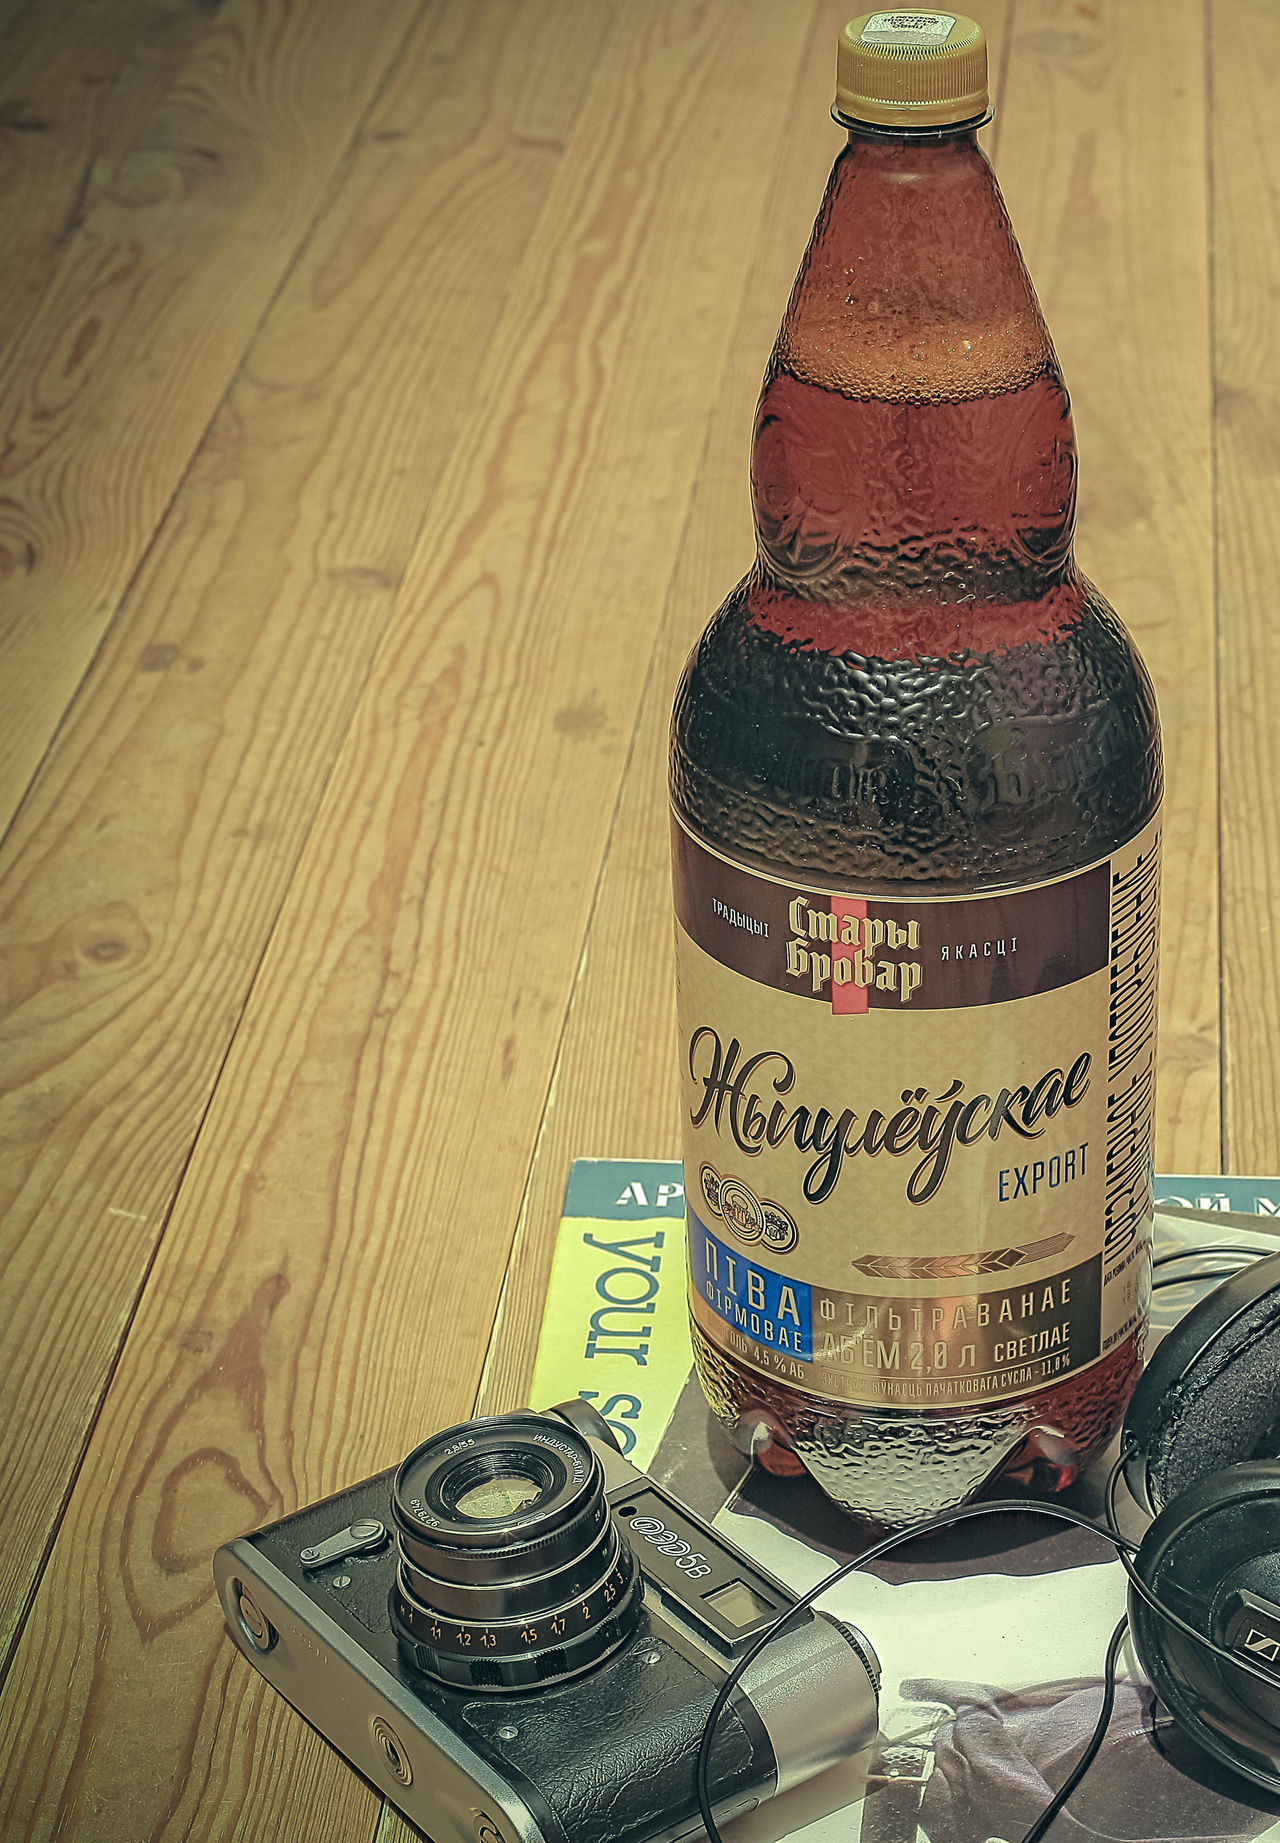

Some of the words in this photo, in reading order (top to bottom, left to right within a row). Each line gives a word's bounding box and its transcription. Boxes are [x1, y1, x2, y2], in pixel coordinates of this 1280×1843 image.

[712, 897, 769, 938] ТРАДЫЦЫІ
[788, 895, 920, 959] Стары
[785, 937, 923, 1004] Бровар
[941, 936, 1018, 962] ЯКАСЦІ
[616, 1181, 684, 1208] АР
[998, 1142, 1089, 1203] EXPORT
[583, 1231, 665, 1367] your
[706, 1237, 801, 1326] ПІВА
[820, 1278, 1071, 1332] ФІЛЬТРАВАНАЕ
[706, 1280, 803, 1353] ФІРМОВАЕ
[754, 1346, 770, 1366] 4,5
[774, 1354, 786, 1373] %
[910, 1341, 947, 1374] 2,0
[994, 1321, 1071, 1363] СВЕТЛАЕ
[926, 1373, 998, 1397] ПАЧАТКОВАГА
[1001, 1366, 1032, 1387] СУСЛА
[409, 1498, 441, 1528] 9279749
[430, 1625, 442, 1640] 1,1
[456, 1632, 471, 1647] 1,2
[480, 1634, 497, 1648] 1,3
[521, 1629, 538, 1644] 1,5
[550, 1618, 567, 1635] 1,7
[582, 1606, 591, 1620] 2
[603, 1585, 616, 1602] 2,5
